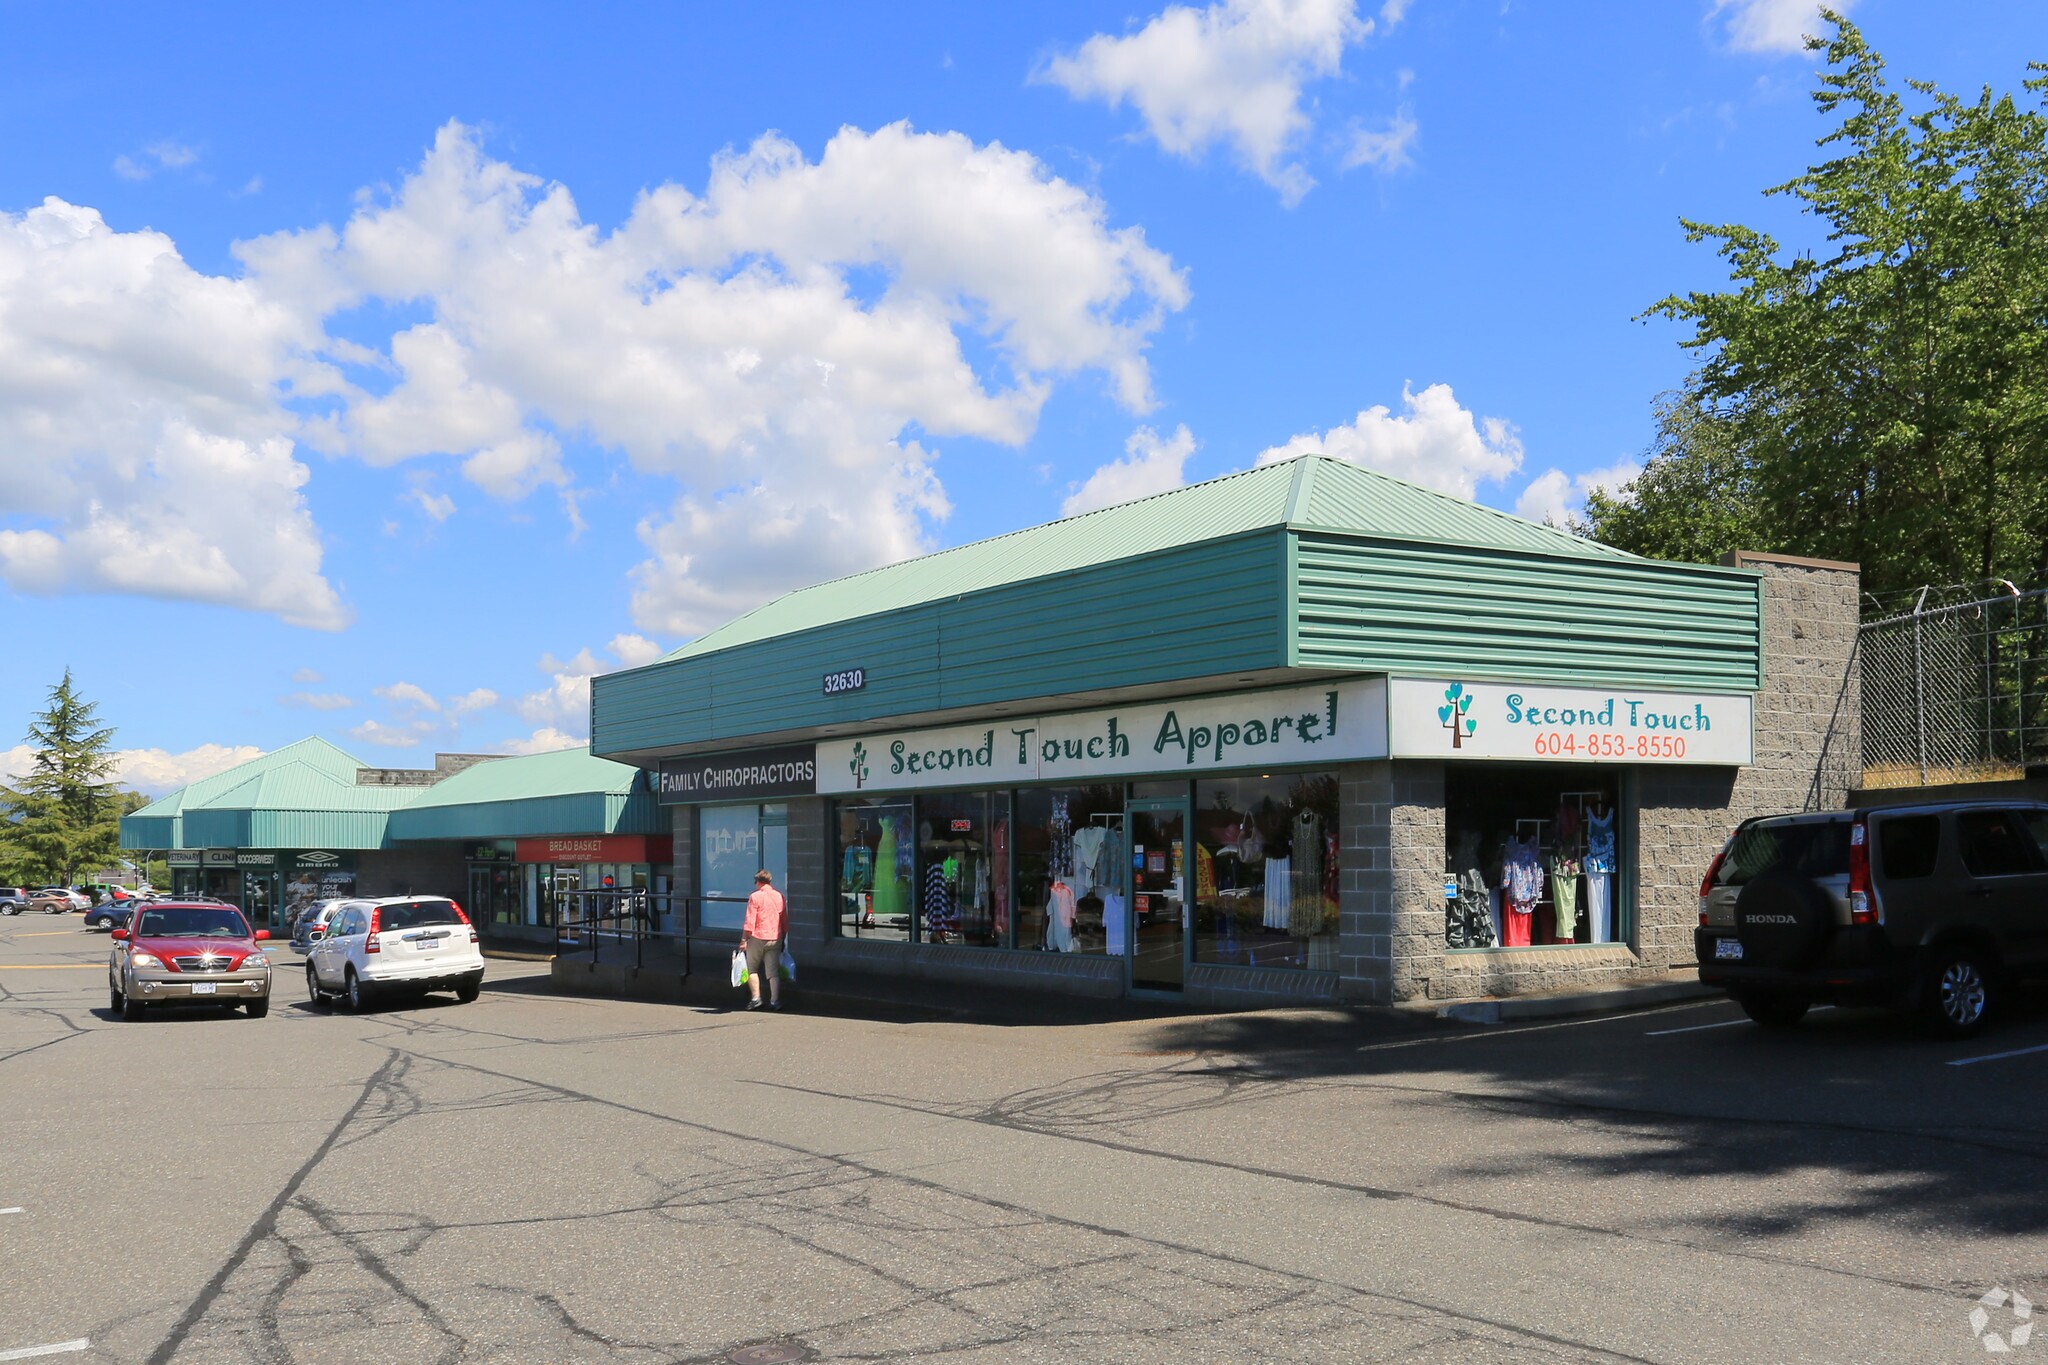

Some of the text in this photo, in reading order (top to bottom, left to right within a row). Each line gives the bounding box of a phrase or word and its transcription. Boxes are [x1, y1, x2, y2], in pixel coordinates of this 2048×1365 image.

[825, 670, 862, 693] 32630
[1505, 693, 1711, 731] Second Touch
[890, 690, 1338, 774] Second Touch Apparel
[1534, 732, 1686, 758] 604-853-8550
[660, 760, 814, 792] FAMILY CHIROPRACTORS
[549, 840, 602, 852] BREAD BASKET
[237, 854, 274, 864] SOCCERWEST
[321, 876, 352, 884] unleash
[321, 884, 338, 892] your
[1745, 914, 1797, 924] HONDA
